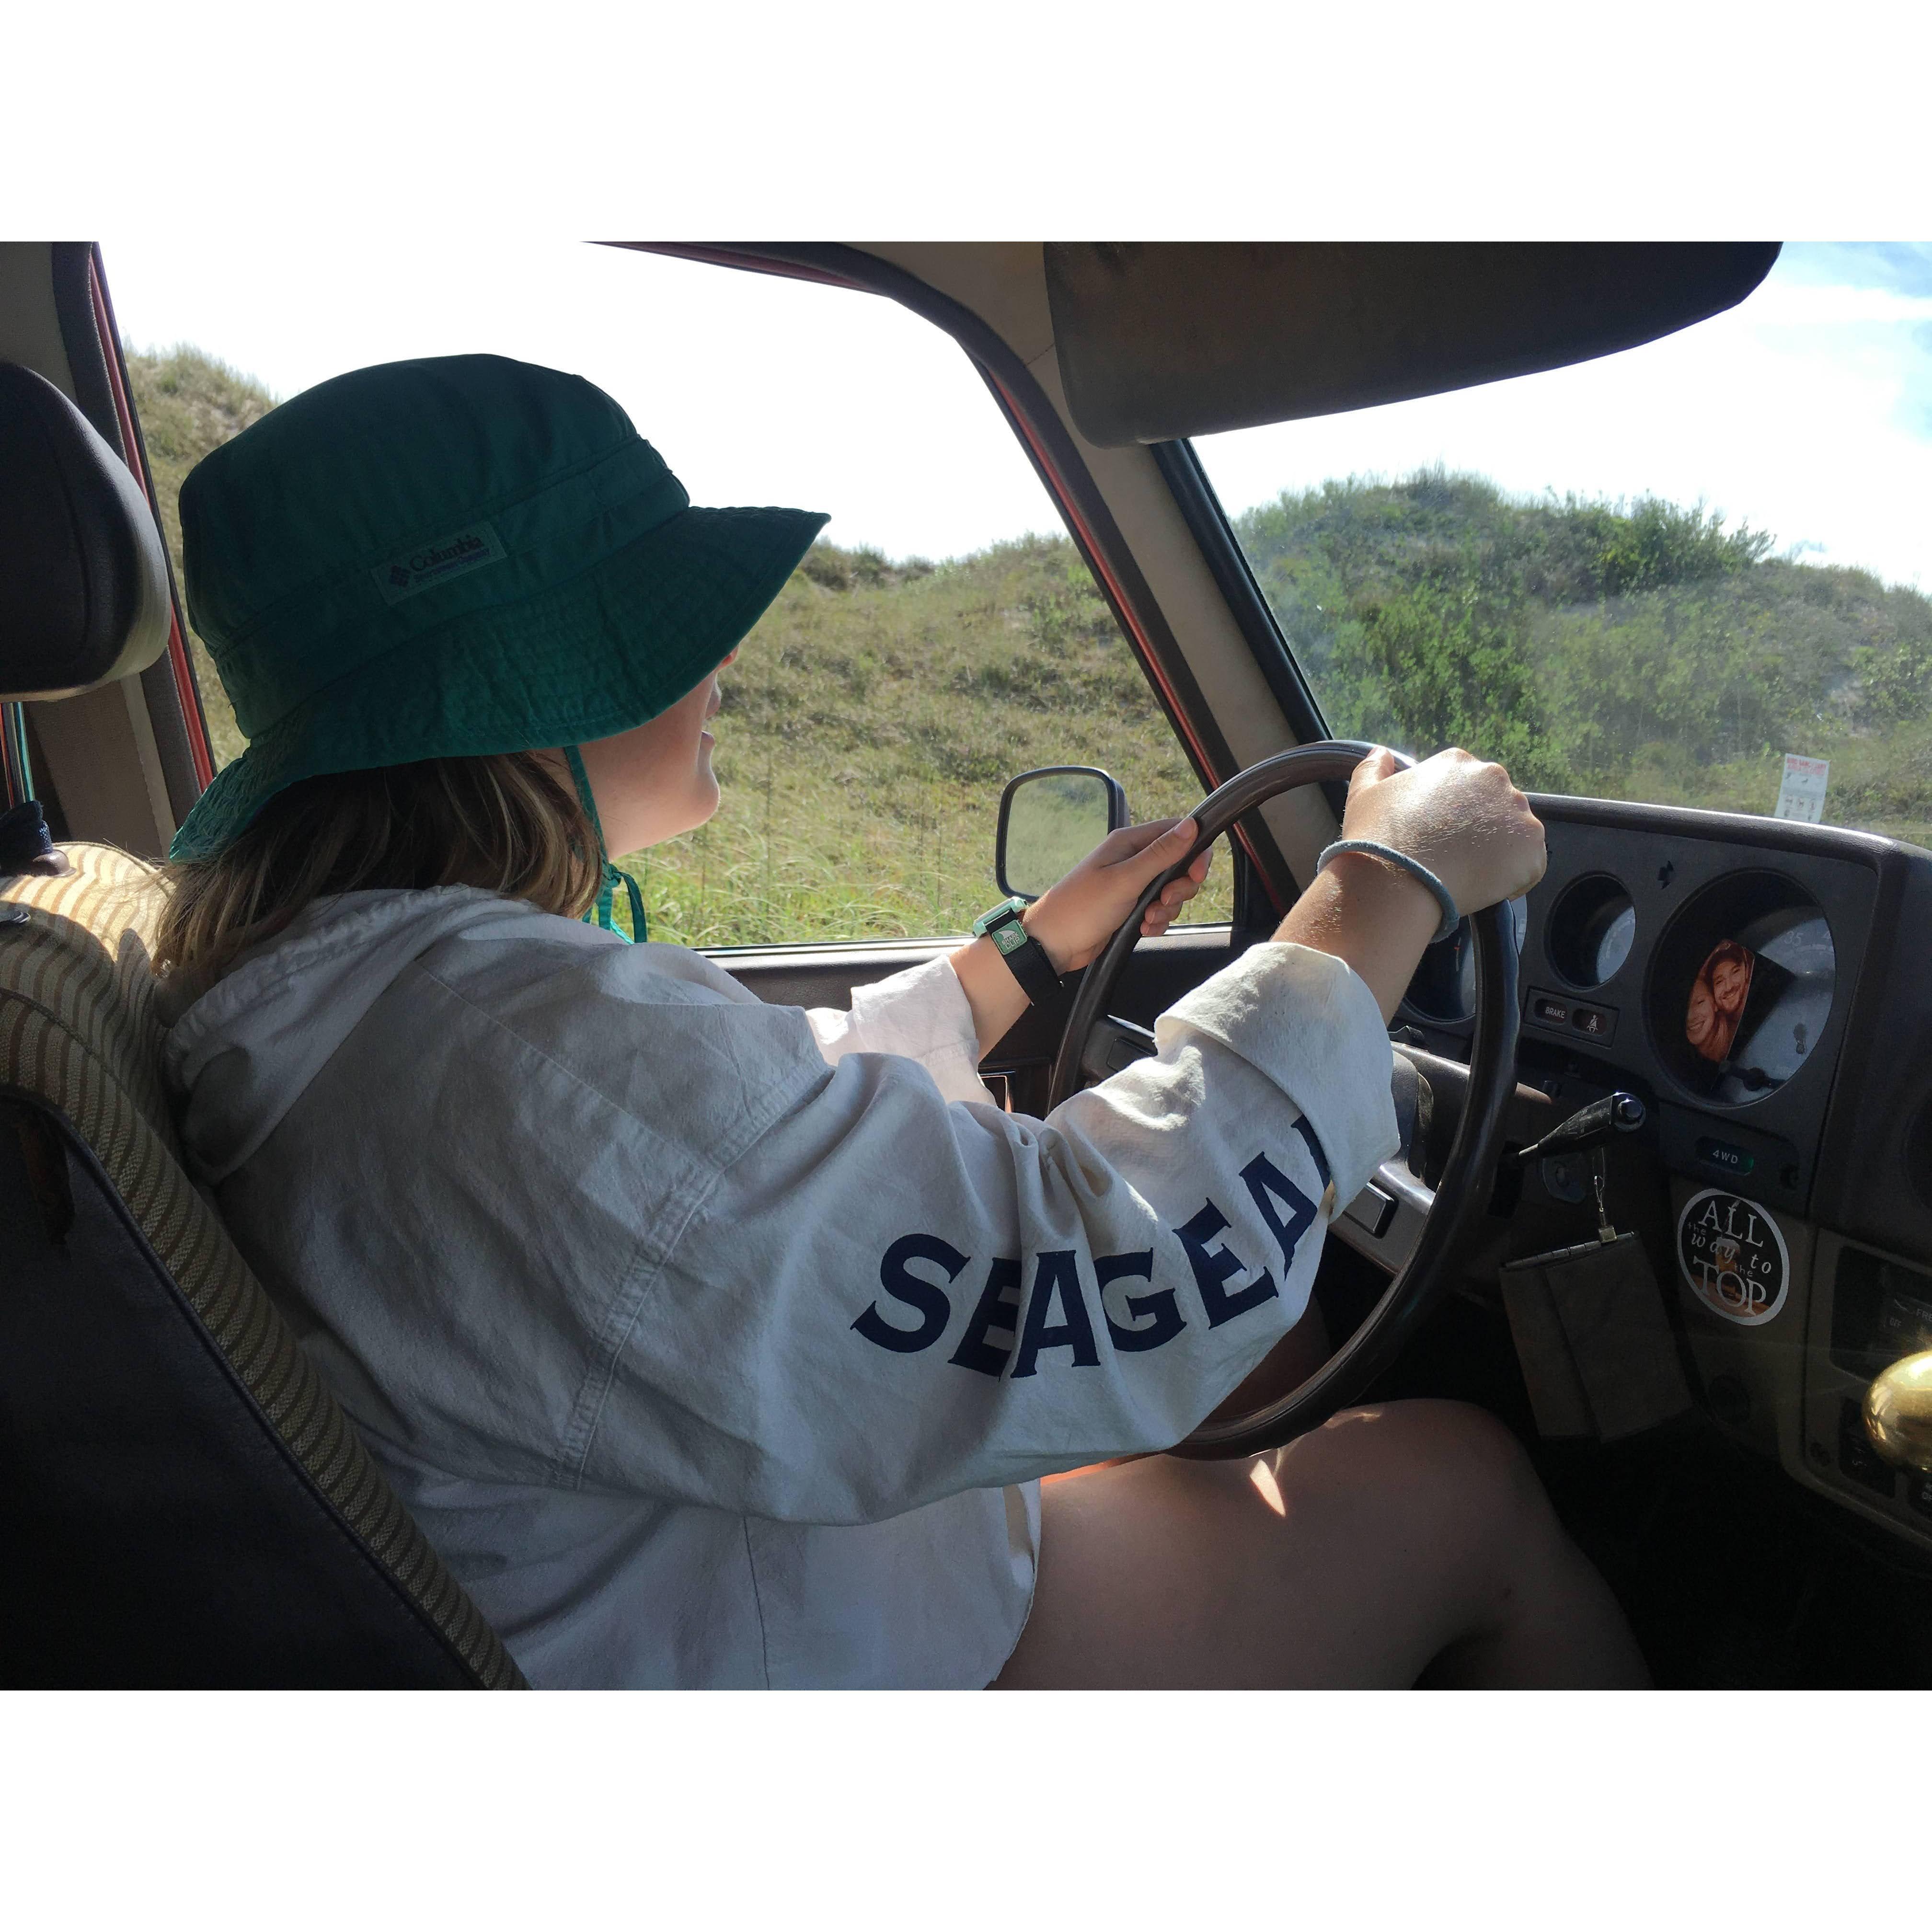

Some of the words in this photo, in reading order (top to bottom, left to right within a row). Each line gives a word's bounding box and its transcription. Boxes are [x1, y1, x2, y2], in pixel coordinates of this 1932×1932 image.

[410, 535, 484, 571] Columbia
[1002, 932, 1019, 944] SHARK
[1005, 937, 1020, 949] CLIP
[1784, 931, 1803, 946] 35
[1545, 1007, 1566, 1019] BRAKE
[1713, 1150, 1738, 1164] 4WD
[1687, 1222, 1706, 1236] the
[1698, 1200, 1764, 1247] ALL
[1691, 1233, 1736, 1264] way
[1750, 1254, 1771, 1274] to
[1734, 1263, 1753, 1277] the
[1693, 1255, 1767, 1315] TOP
[1889, 1317, 1902, 1328] OFF
